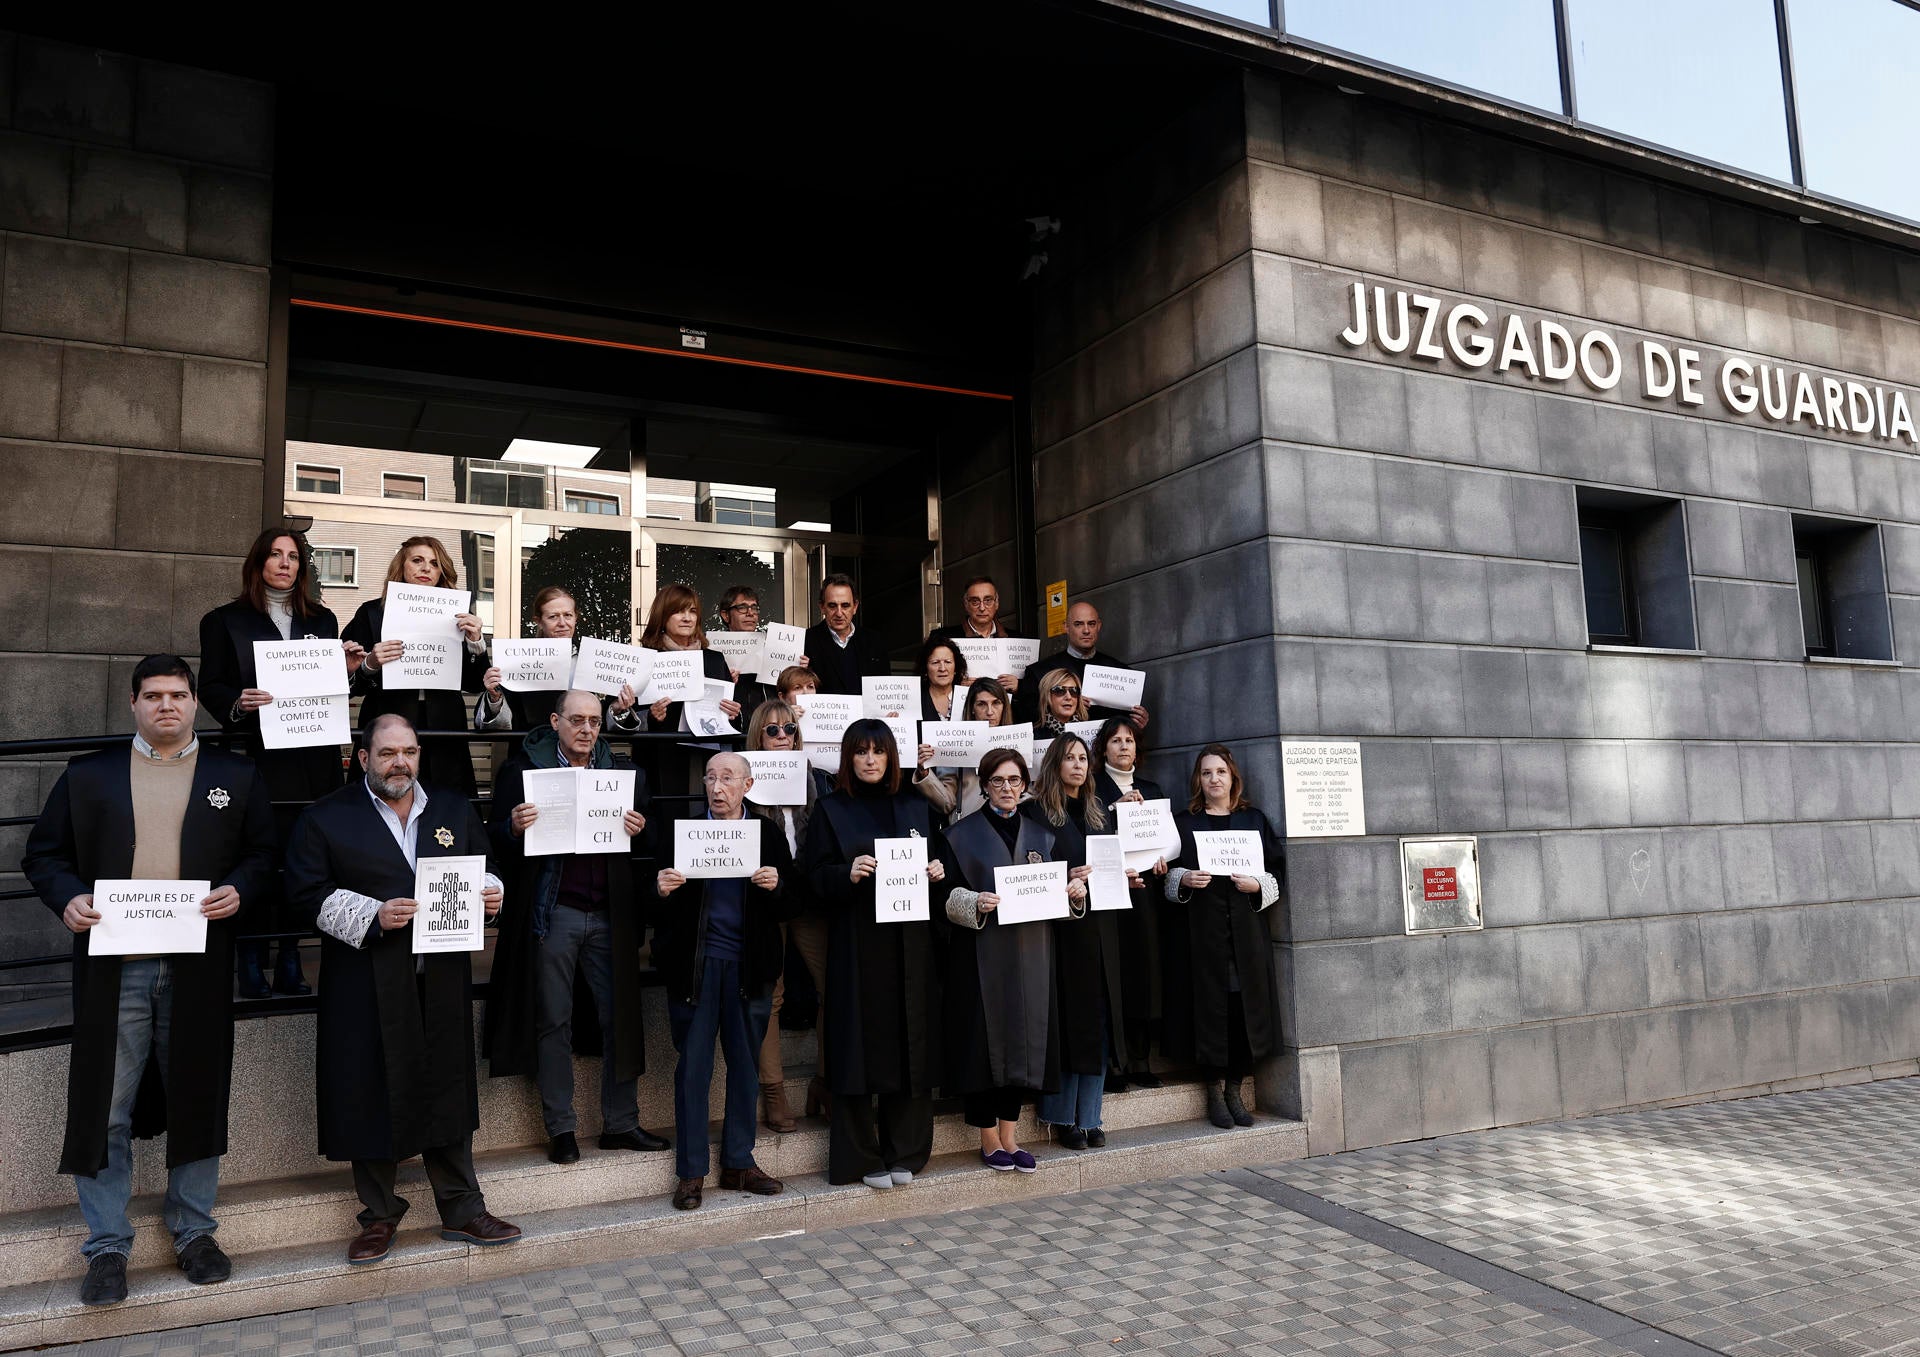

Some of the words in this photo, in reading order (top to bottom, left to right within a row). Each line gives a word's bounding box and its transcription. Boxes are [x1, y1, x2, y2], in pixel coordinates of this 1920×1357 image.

[1339, 282, 1622, 391] JUZGADO
[1642, 340, 1704, 405] DE
[1718, 357, 1919, 443] GUARDIA
[397, 592, 435, 604] CUMPLIR
[437, 596, 447, 605] ES
[448, 598, 460, 606] DE
[778, 631, 795, 642] LAJ
[403, 643, 415, 651] AJS
[417, 643, 436, 652] CON
[437, 644, 447, 653] EL
[505, 647, 559, 657] CUMPLIR:
[266, 649, 307, 660] CUMPLIR
[309, 649, 320, 658] ES
[322, 648, 334, 657] DE
[595, 649, 612, 658] LAJS
[613, 652, 631, 661] CON
[631, 655, 640, 664] EL
[770, 651, 785, 660] con
[787, 653, 796, 662] el
[400, 655, 431, 664] COMITÉ
[433, 656, 444, 664] DE
[533, 660, 544, 669] de
[653, 660, 665, 669] AJS
[666, 659, 682, 668] CON
[683, 659, 691, 667] EL
[281, 662, 322, 672] JUSTICIA.
[404, 668, 438, 676] HUELGA.
[594, 661, 624, 673] COMITÉ
[626, 666, 637, 675] DE
[507, 672, 555, 681] JUSTICIA
[652, 671, 680, 680] COMITÉ
[681, 670, 691, 678] DE
[1091, 672, 1119, 681] CUMPLIR
[1120, 675, 1128, 683] ES
[277, 699, 297, 709] LAJS
[298, 698, 319, 707] CON
[322, 697, 331, 706] EL
[280, 711, 315, 722] COMITÉ
[317, 710, 329, 719] DE
[812, 711, 839, 720] COMITÉ
[286, 724, 325, 734] HUELGA.
[935, 729, 951, 737] LAJS
[951, 729, 967, 737] CON
[1020, 731, 1028, 739] DE
[1286, 747, 1316, 755] JUZGADO
[1318, 747, 1328, 755] DE
[1330, 747, 1357, 755] GUARDIA
[749, 760, 777, 768] UMPLIR
[778, 760, 787, 768] ES
[788, 760, 799, 768] DE
[1286, 757, 1323, 765] GUARDIAKO
[1326, 757, 1358, 765] EPAITEGIA
[595, 780, 619, 792] LAJ
[588, 809, 609, 818] con
[612, 806, 623, 817] el
[1130, 820, 1151, 829] COMITÉ
[593, 831, 612, 843] CH
[688, 830, 746, 840] CUMPLIR:
[704, 846, 715, 854] es
[717, 844, 730, 854] de
[891, 848, 913, 860] LAJ
[1230, 847, 1240, 855] de
[690, 857, 743, 868] JUSTICIA
[1211, 858, 1251, 867] JUSTICIA
[443, 872, 460, 882] POR
[886, 876, 905, 886] con
[908, 873, 918, 885] el
[1004, 874, 1038, 884] CUMPLIR
[1039, 873, 1048, 881] ES
[1049, 871, 1059, 880] DE
[428, 881, 472, 893] DIGNIDAD,
[109, 893, 161, 903] CUMPLIR
[164, 893, 177, 903] ES
[180, 893, 195, 903] DE
[442, 891, 459, 901] POR
[1427, 890, 1455, 898] BOMBEROS
[892, 899, 911, 912] CH
[124, 909, 177, 919] JUSTICIA.
[441, 910, 458, 920] POR
[428, 919, 469, 931] IGUALDAD
